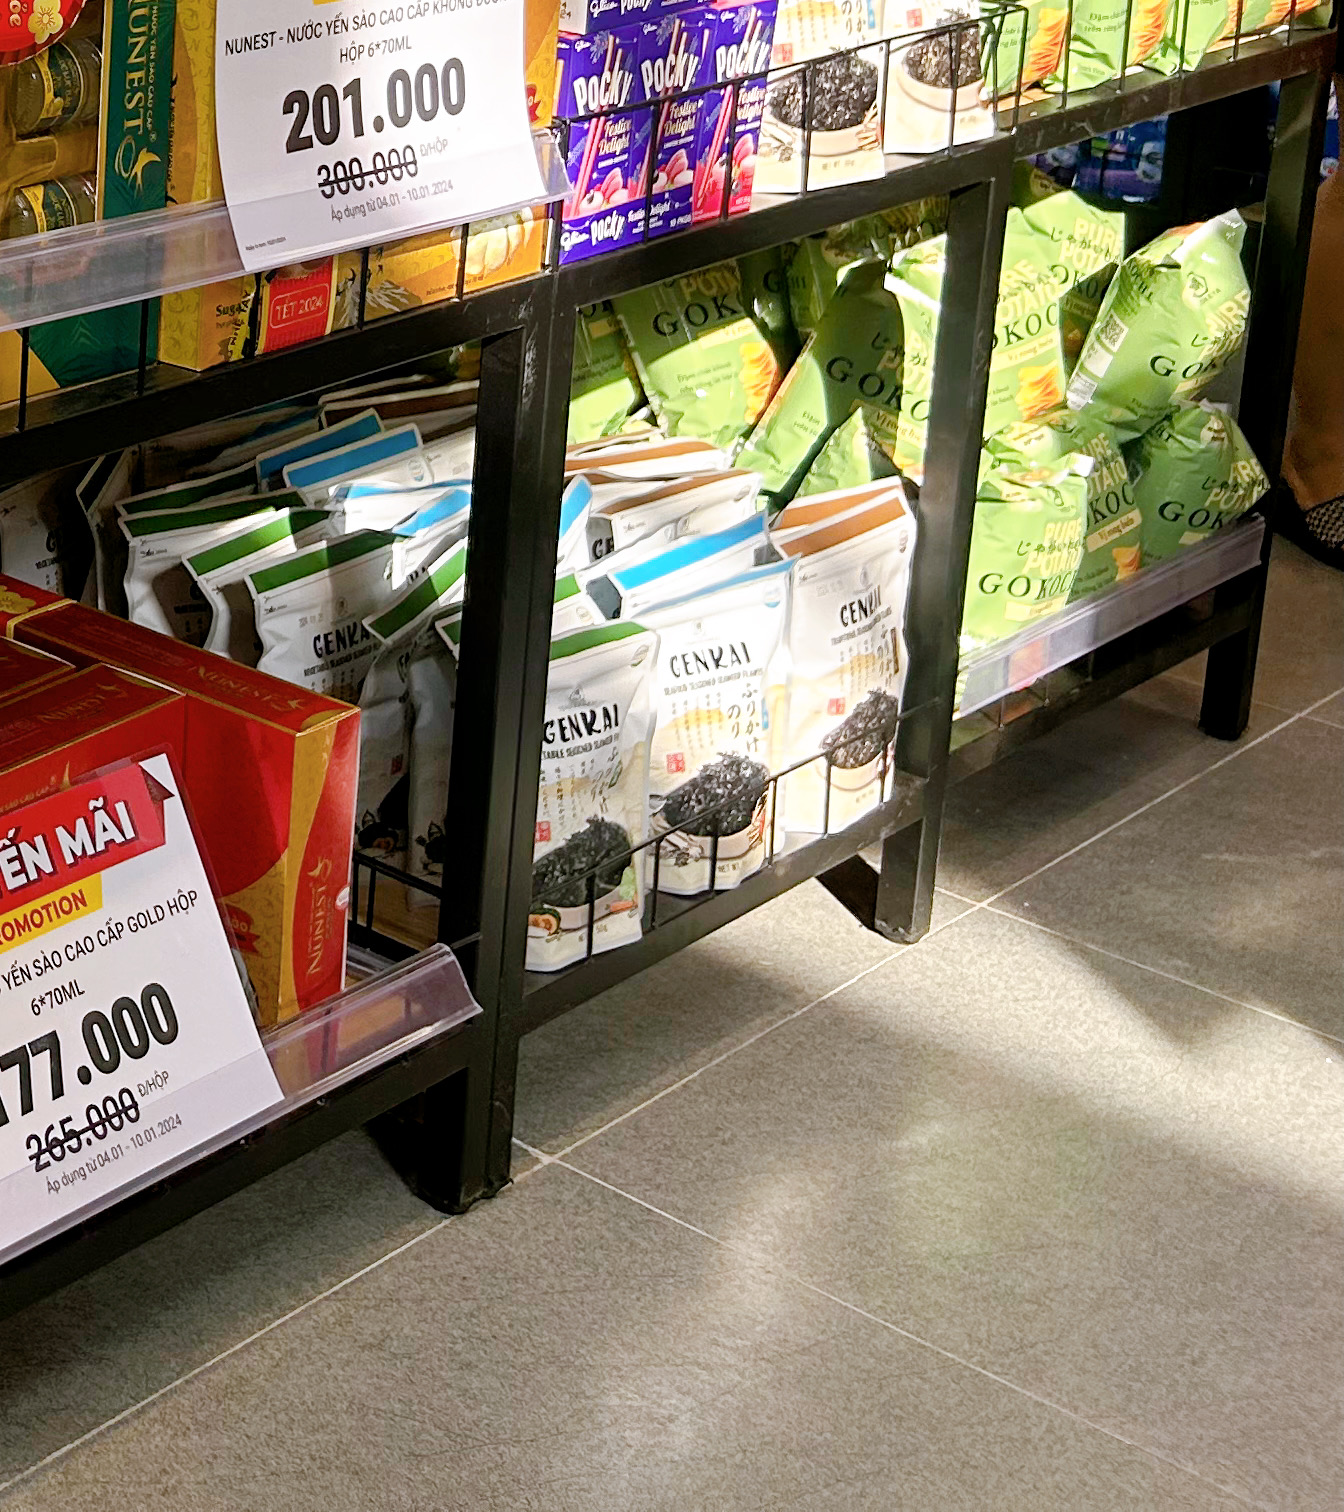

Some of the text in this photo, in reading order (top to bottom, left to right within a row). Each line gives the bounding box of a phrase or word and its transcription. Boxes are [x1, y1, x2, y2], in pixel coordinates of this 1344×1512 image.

[283, 57, 466, 154] 201.000
[669, 642, 750, 677] GENKAI
[61, 799, 136, 866] MÃI
